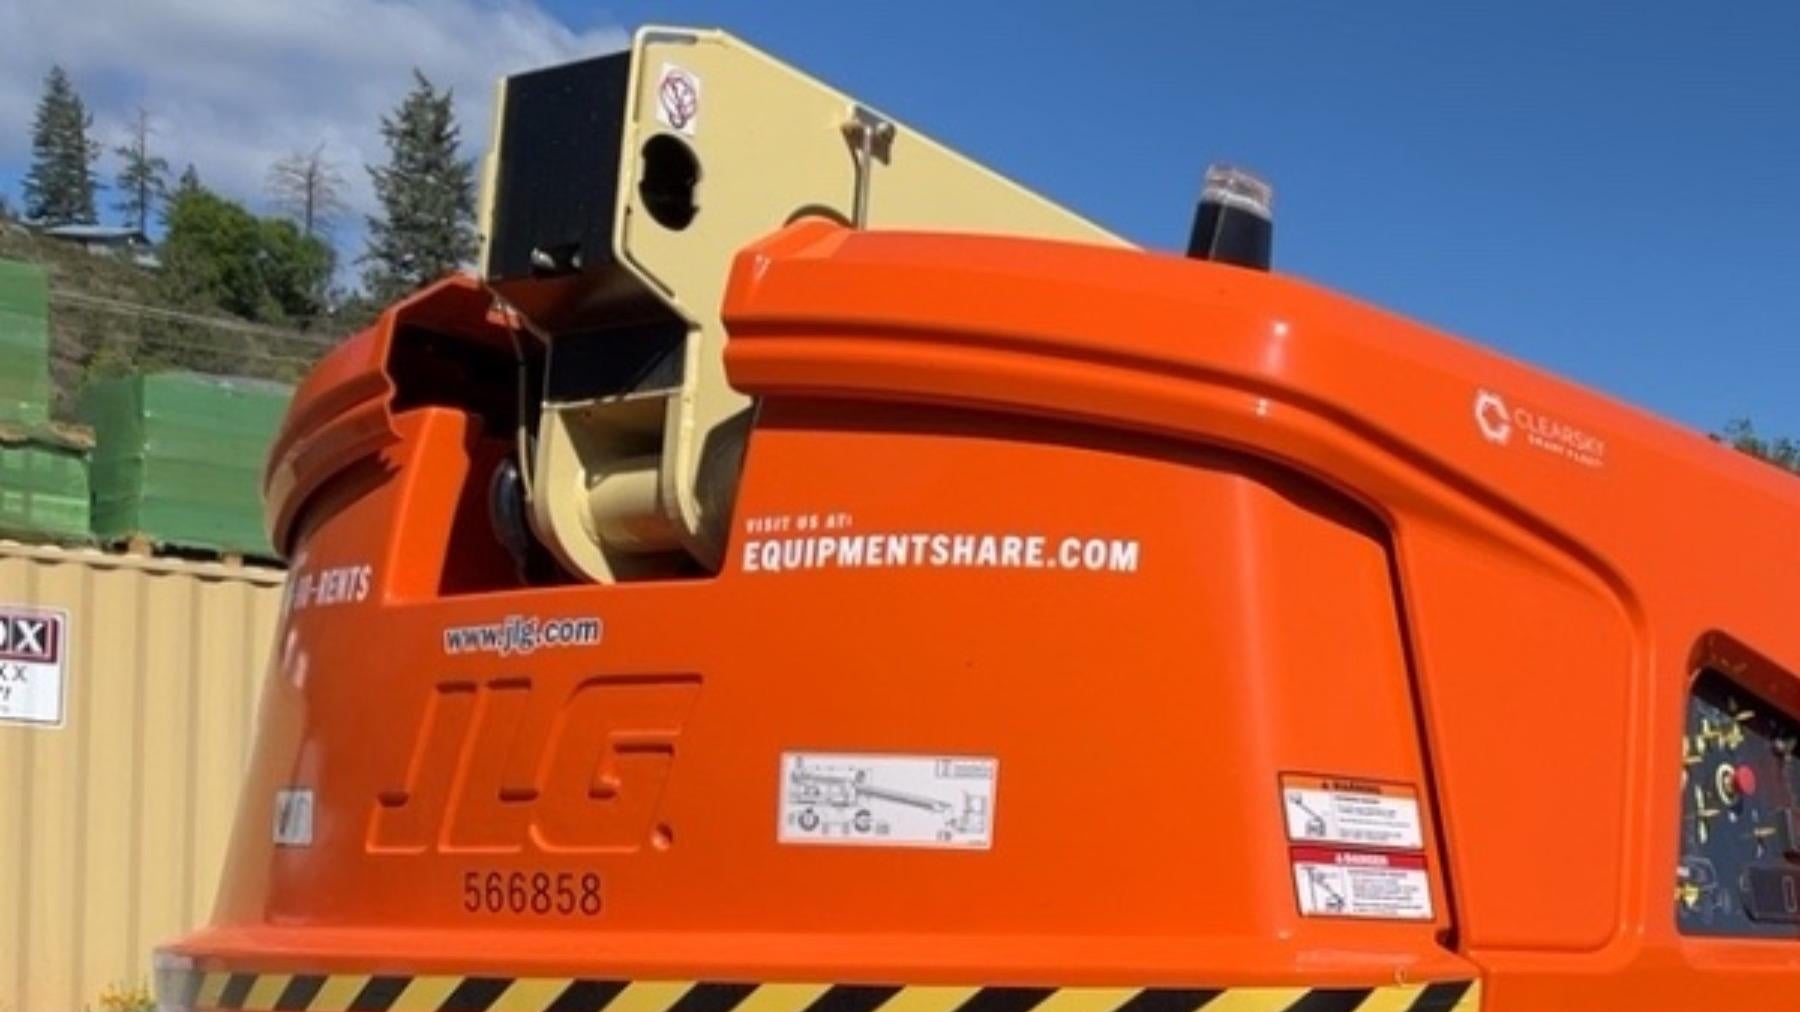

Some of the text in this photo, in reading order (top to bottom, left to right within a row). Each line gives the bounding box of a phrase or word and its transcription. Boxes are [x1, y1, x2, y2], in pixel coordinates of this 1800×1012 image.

[742, 533, 1139, 572] EQUIPMENTSHARE.COM
[444, 613, 602, 656] www.jlg.com
[463, 870, 603, 916] 566858
